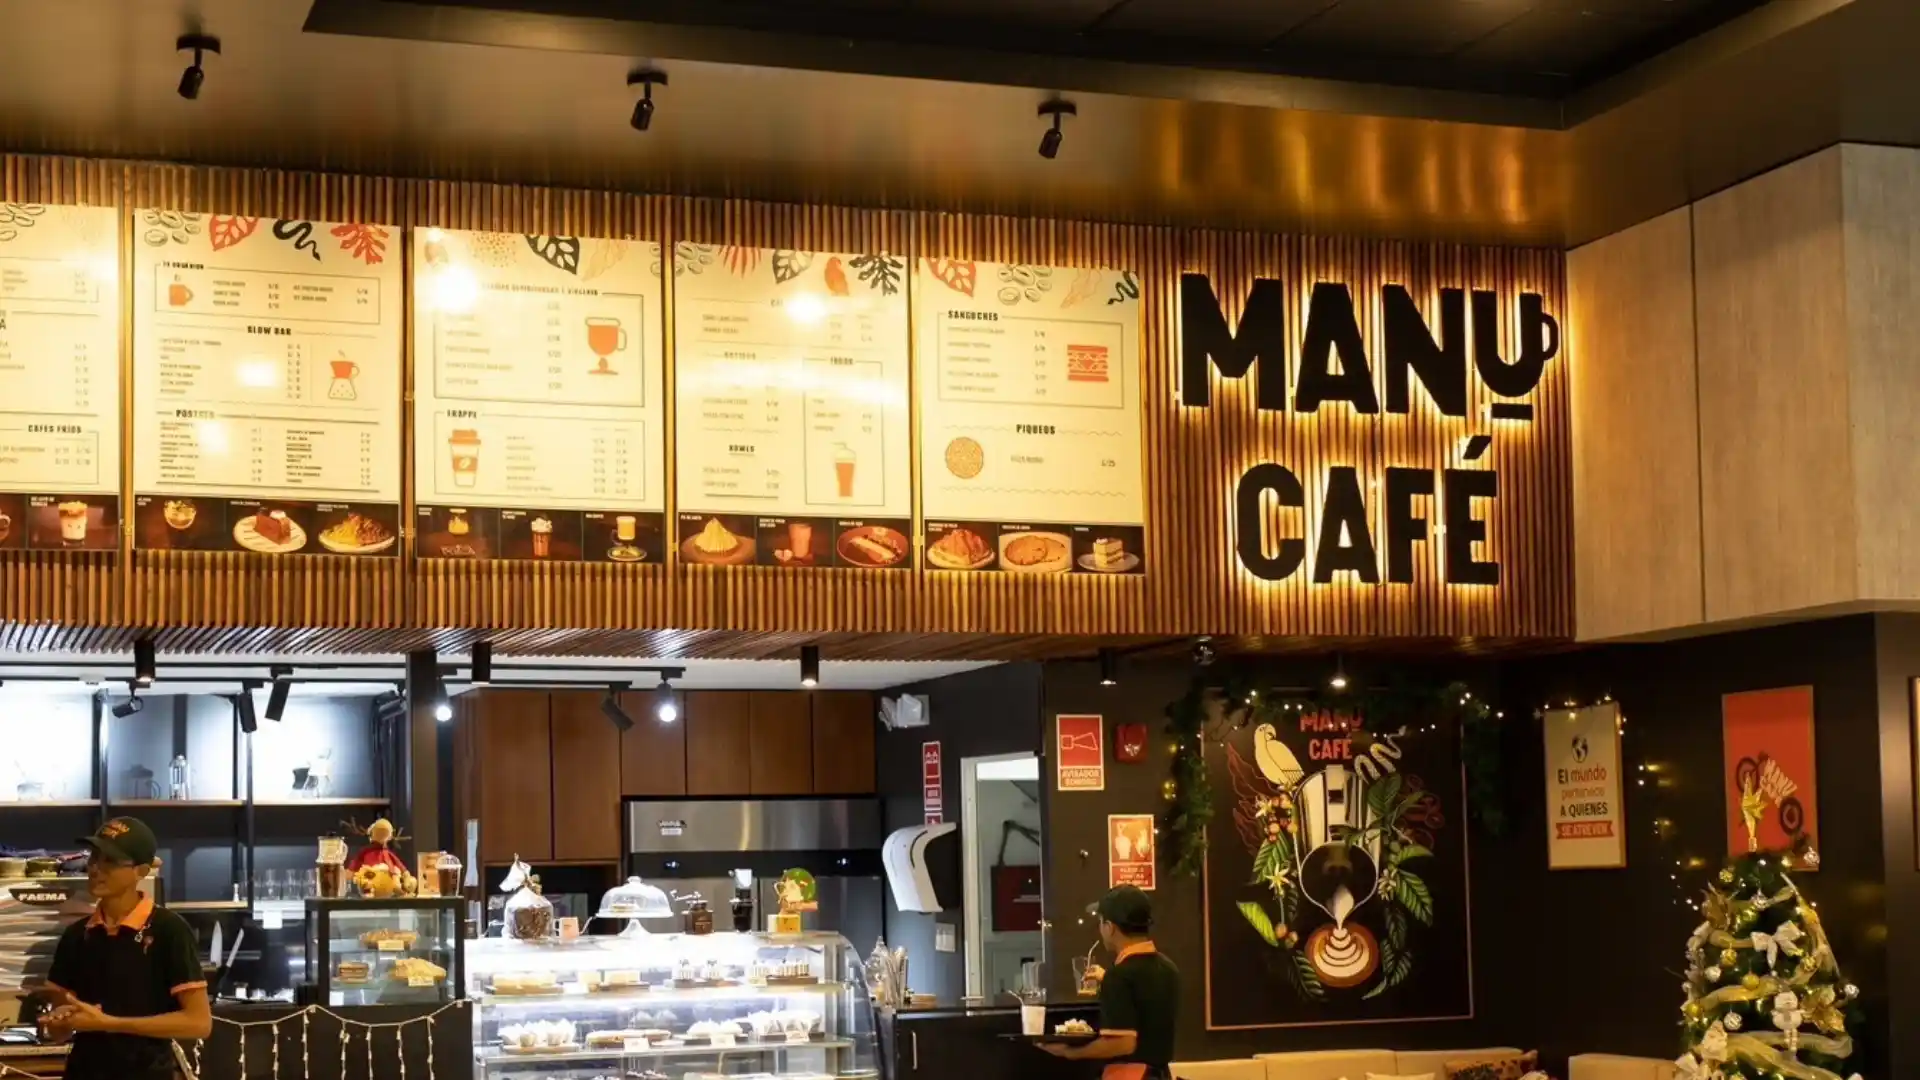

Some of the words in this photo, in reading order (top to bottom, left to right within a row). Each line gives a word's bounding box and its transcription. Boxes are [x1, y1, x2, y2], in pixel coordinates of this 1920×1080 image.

[1181, 273, 1558, 420] MANU
[1237, 435, 1499, 584] CAFÉ
[1561, 804, 1567, 816] A
[1568, 802, 1608, 818] QUIENES
[18, 893, 67, 901] FAEMA
